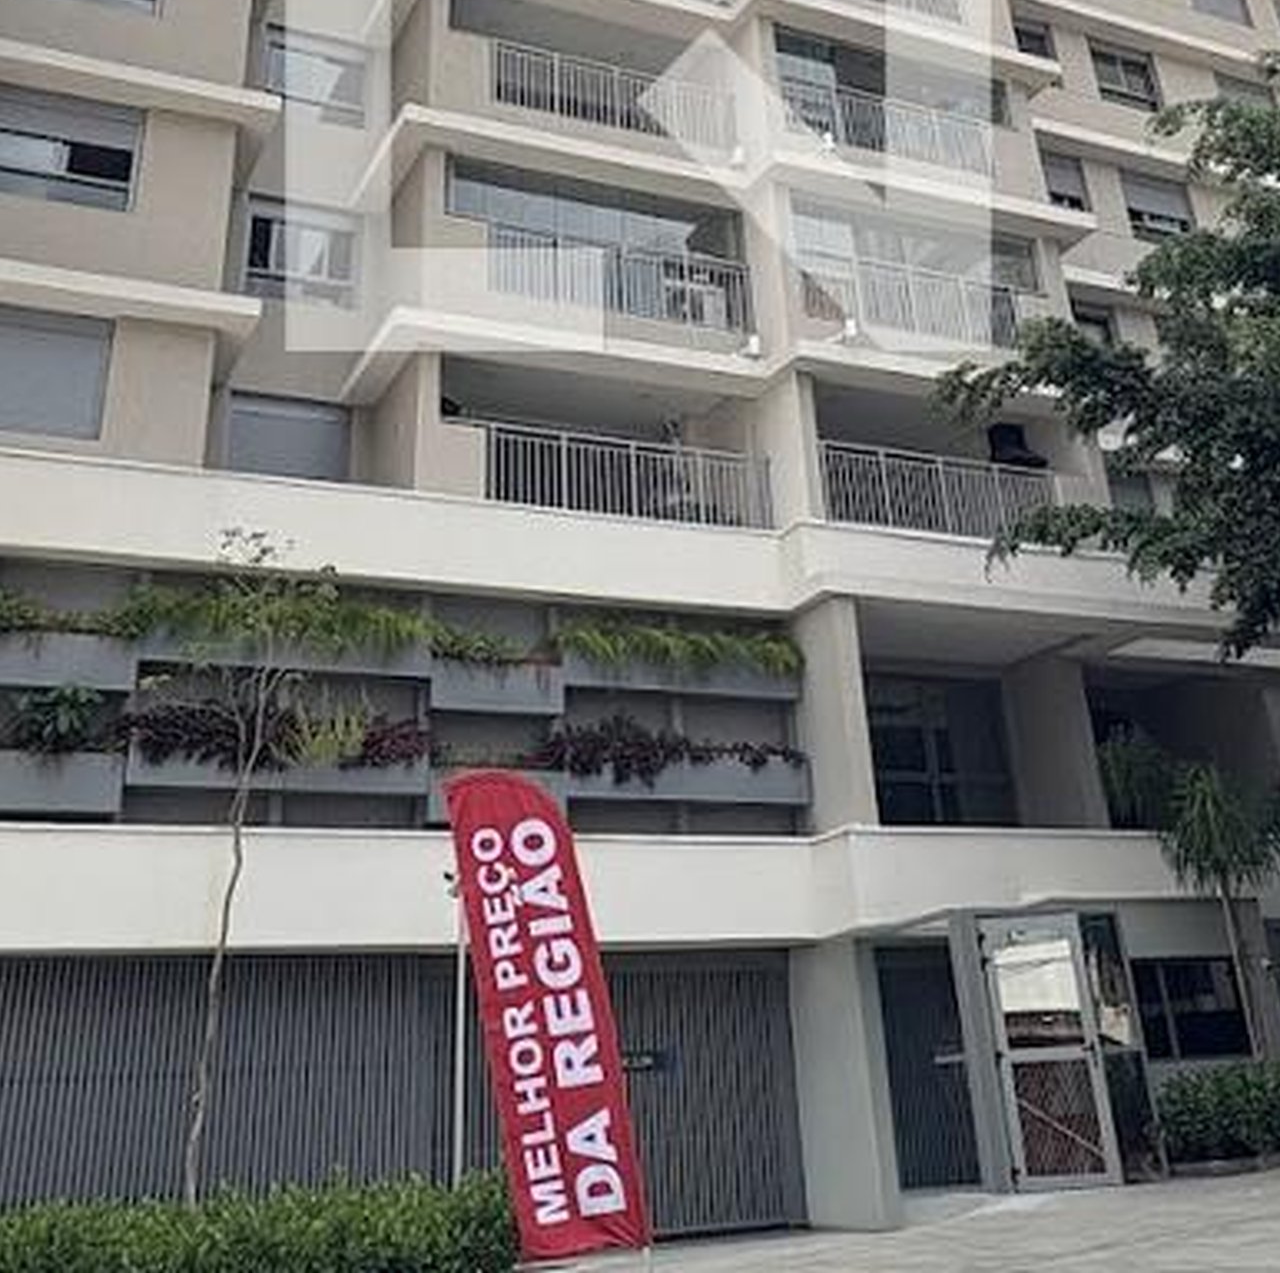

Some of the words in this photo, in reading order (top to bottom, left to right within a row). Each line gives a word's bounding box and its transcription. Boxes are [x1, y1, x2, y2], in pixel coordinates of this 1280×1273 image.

[472, 828, 528, 990] PREÇO
[509, 818, 605, 1088] REGIÃO
[504, 1003, 570, 1225] MELHOR
[566, 1107, 627, 1217] DA
